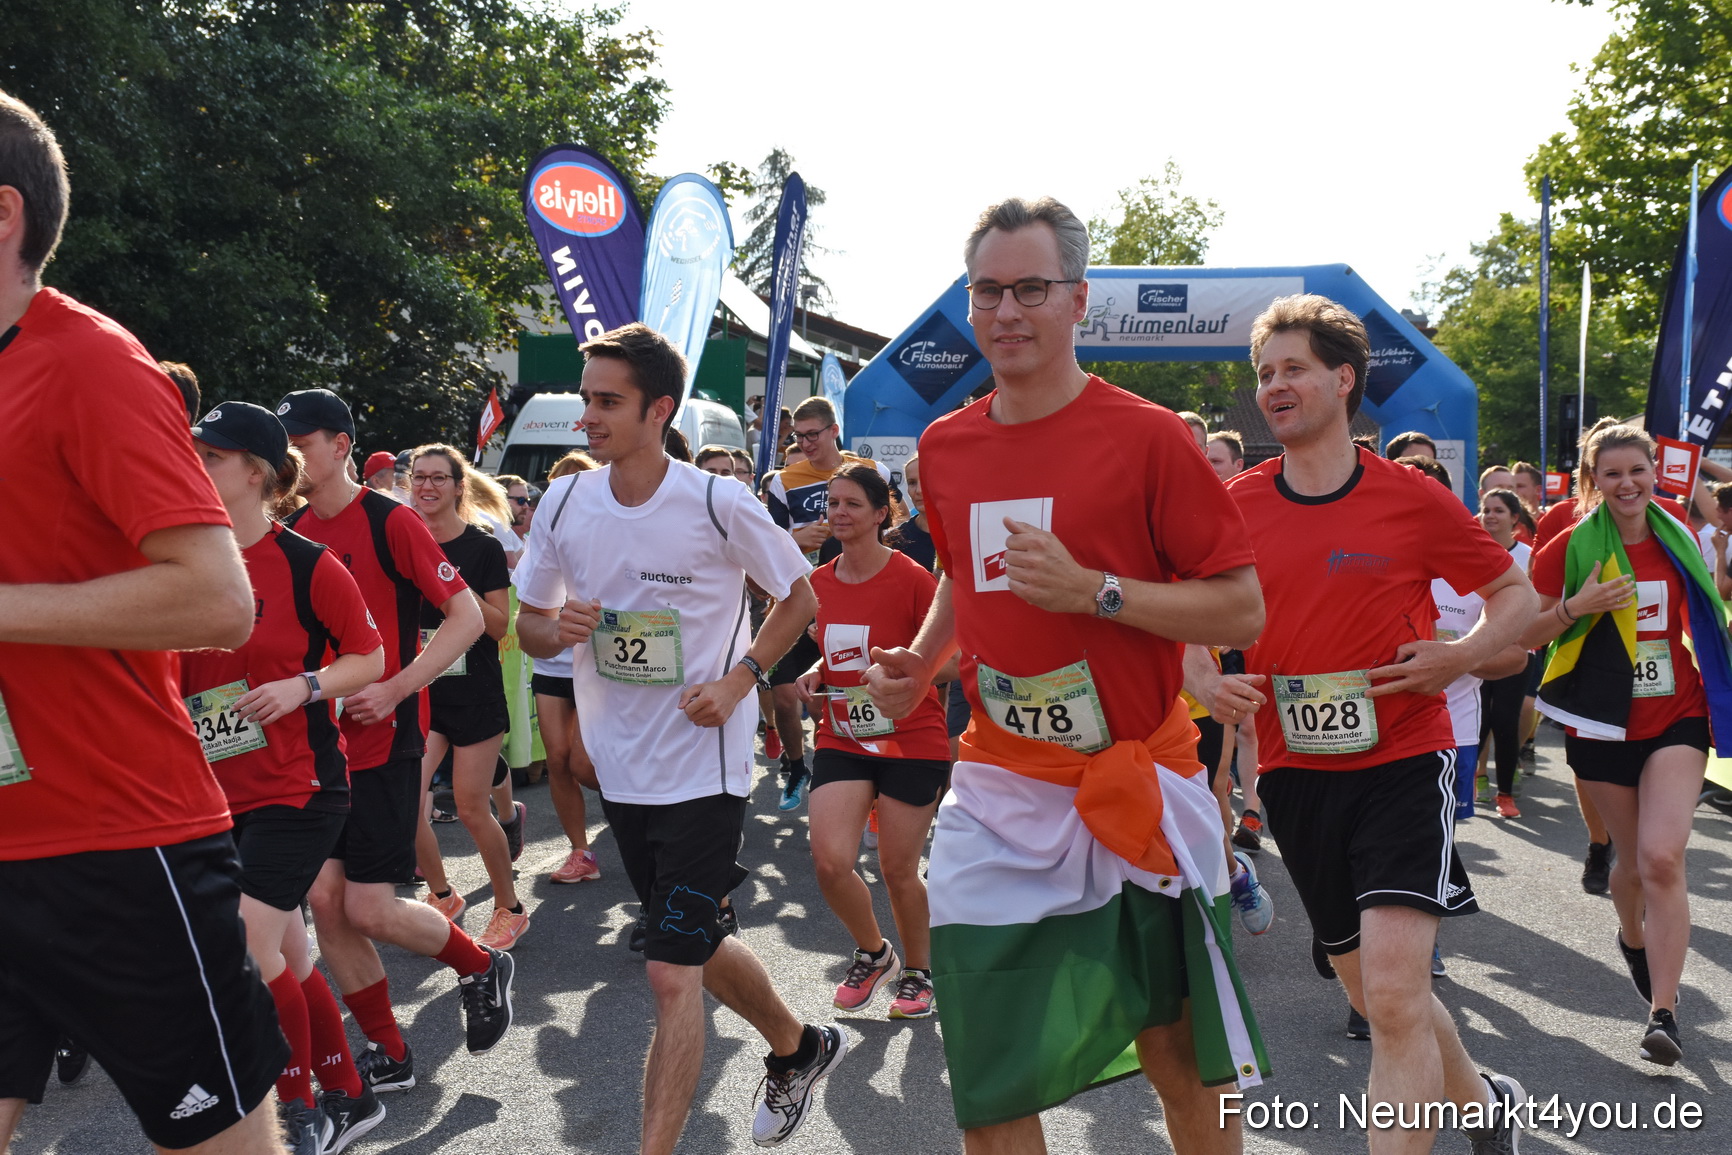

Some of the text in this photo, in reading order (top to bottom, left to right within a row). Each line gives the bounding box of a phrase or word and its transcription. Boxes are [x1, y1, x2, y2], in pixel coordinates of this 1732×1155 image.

[1149, 295, 1185, 303] Fischer
[1120, 314, 1230, 334] firmenlauf
[911, 351, 969, 363] Fischer
[523, 421, 569, 430] abavent
[1327, 548, 1389, 576] Hörmann
[640, 571, 693, 585] auctores
[613, 636, 648, 664] 32
[605, 660, 641, 672] Puschmann
[1633, 661, 1658, 681] 48
[1064, 687, 1087, 701] 2019
[850, 703, 875, 723] 46
[1005, 704, 1073, 735] 478
[1287, 701, 1361, 732] 1028
[223, 736, 241, 745] Nadja
[1047, 733, 1082, 744] Philipp
[1292, 731, 1363, 740] Hörmann Alexander
[170, 1095, 219, 1120] adidas
